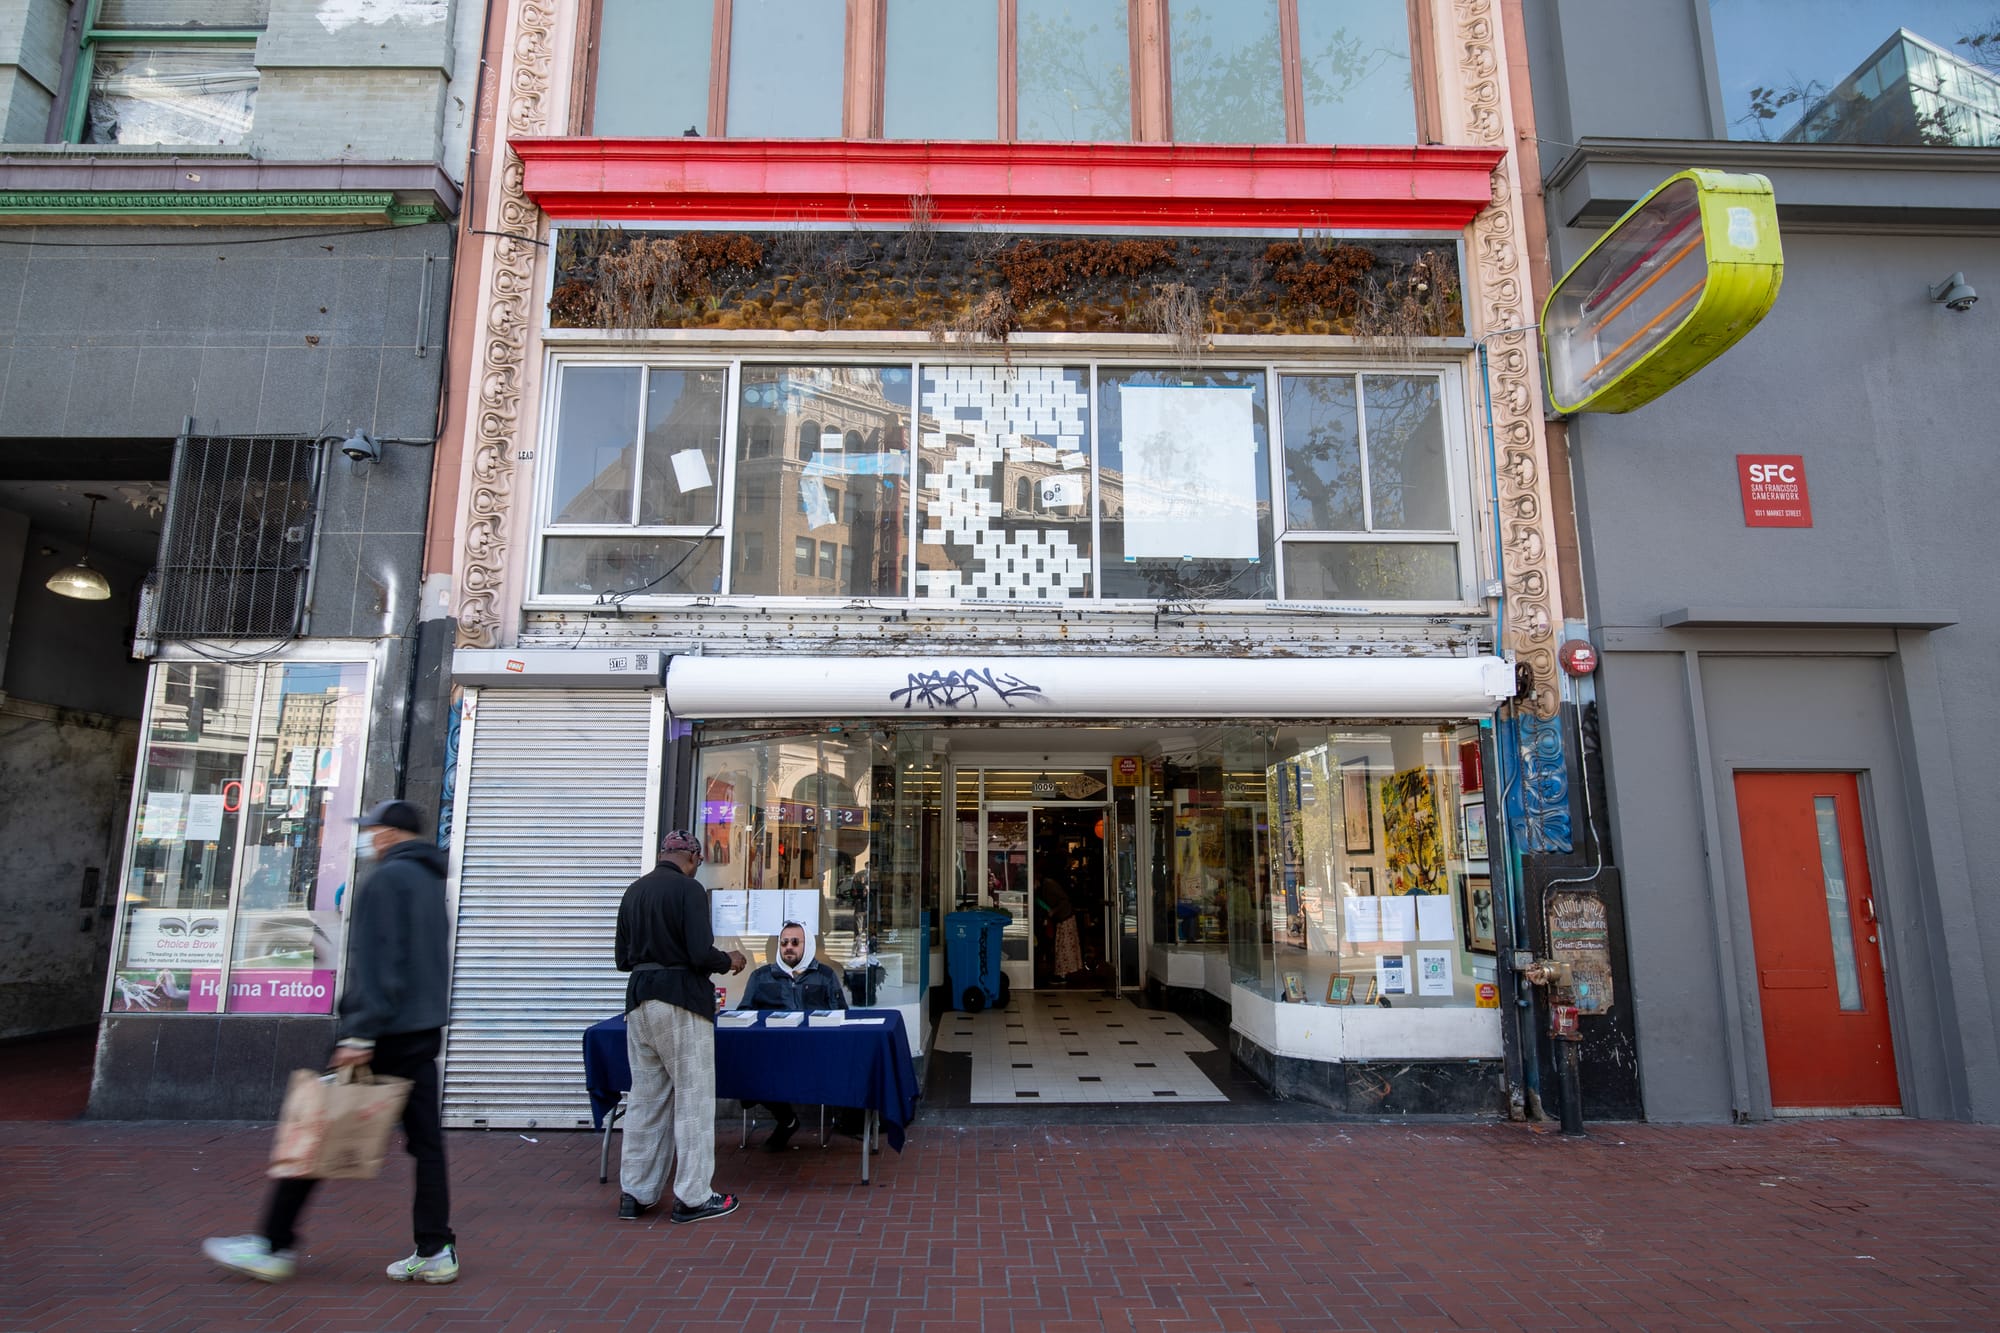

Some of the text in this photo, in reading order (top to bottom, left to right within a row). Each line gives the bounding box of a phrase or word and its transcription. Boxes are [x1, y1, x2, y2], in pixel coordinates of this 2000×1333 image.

[518, 451, 534, 460] LEAD
[1749, 464, 1796, 483] SFC
[1751, 484, 1798, 492] SAN FRANCISCO
[1752, 492, 1800, 501] CAMERAWORK
[1035, 783, 1054, 791] 1009
[156, 939, 218, 949] Choice Brow
[268, 979, 326, 998] Tattoo
